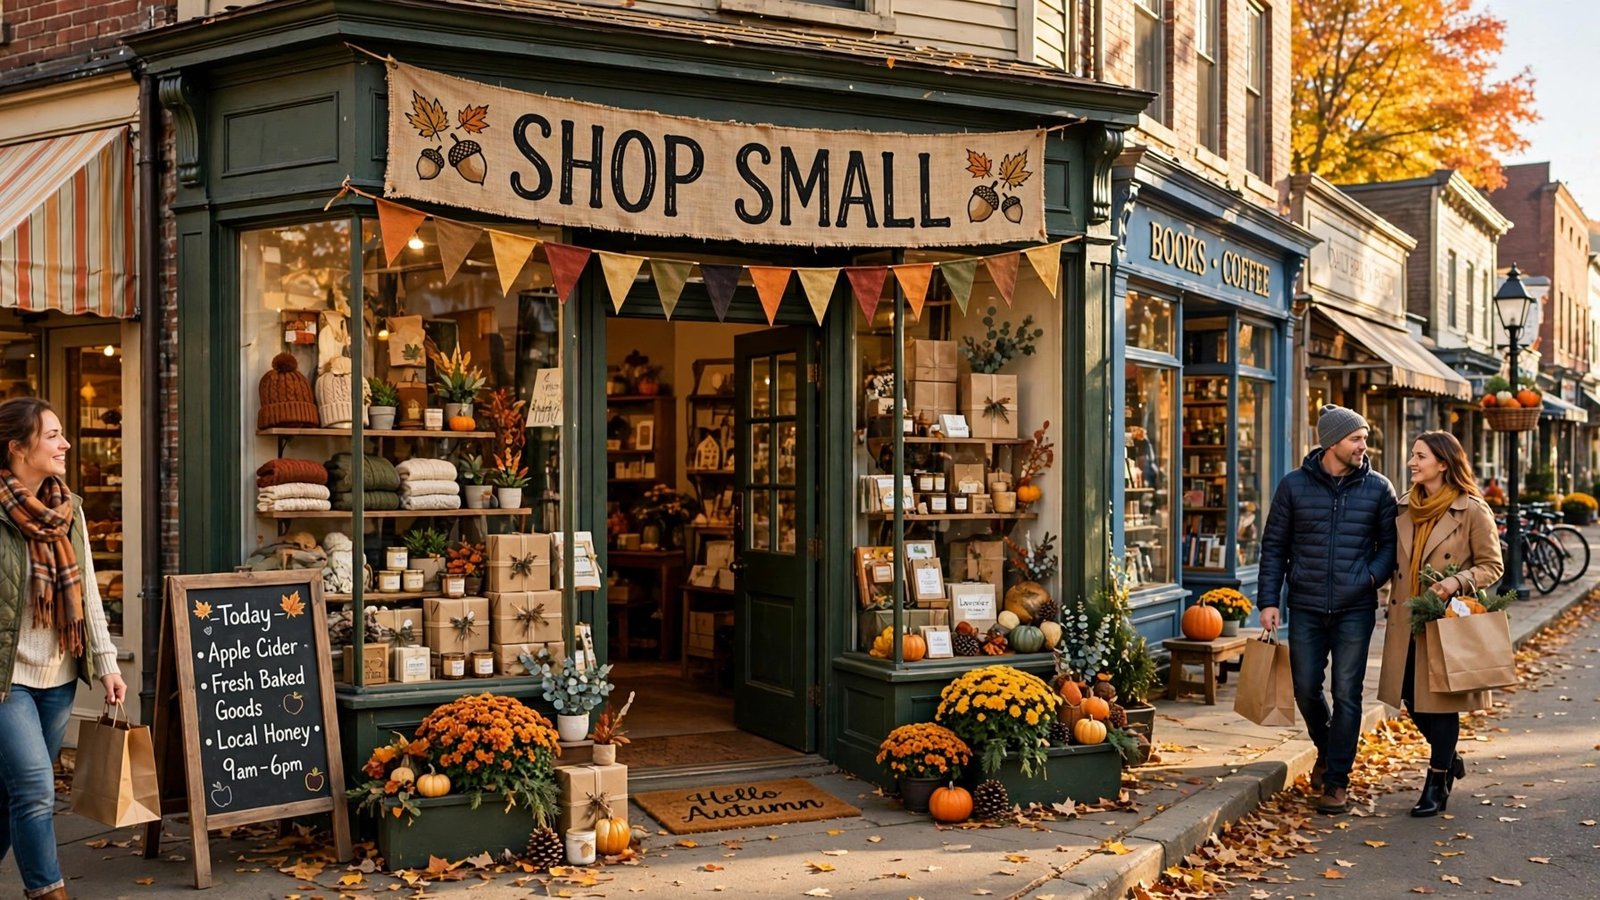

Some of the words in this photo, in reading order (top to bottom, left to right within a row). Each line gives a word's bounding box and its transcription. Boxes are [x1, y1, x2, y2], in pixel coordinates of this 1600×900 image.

[509, 113, 704, 218] SHOP
[734, 141, 951, 229] SMALL
[1149, 220, 1207, 277] BOOKS
[1221, 249, 1271, 299] COFFEE
[208, 639, 251, 669] Apple
[256, 636, 298, 658] Cider
[211, 670, 254, 695] Fresh
[258, 664, 305, 690] Baked
[215, 697, 263, 721] Goods
[216, 724, 258, 750] Local
[263, 722, 310, 748] Honey
[681, 798, 824, 823] Autumn
[686, 786, 782, 807] Hello
